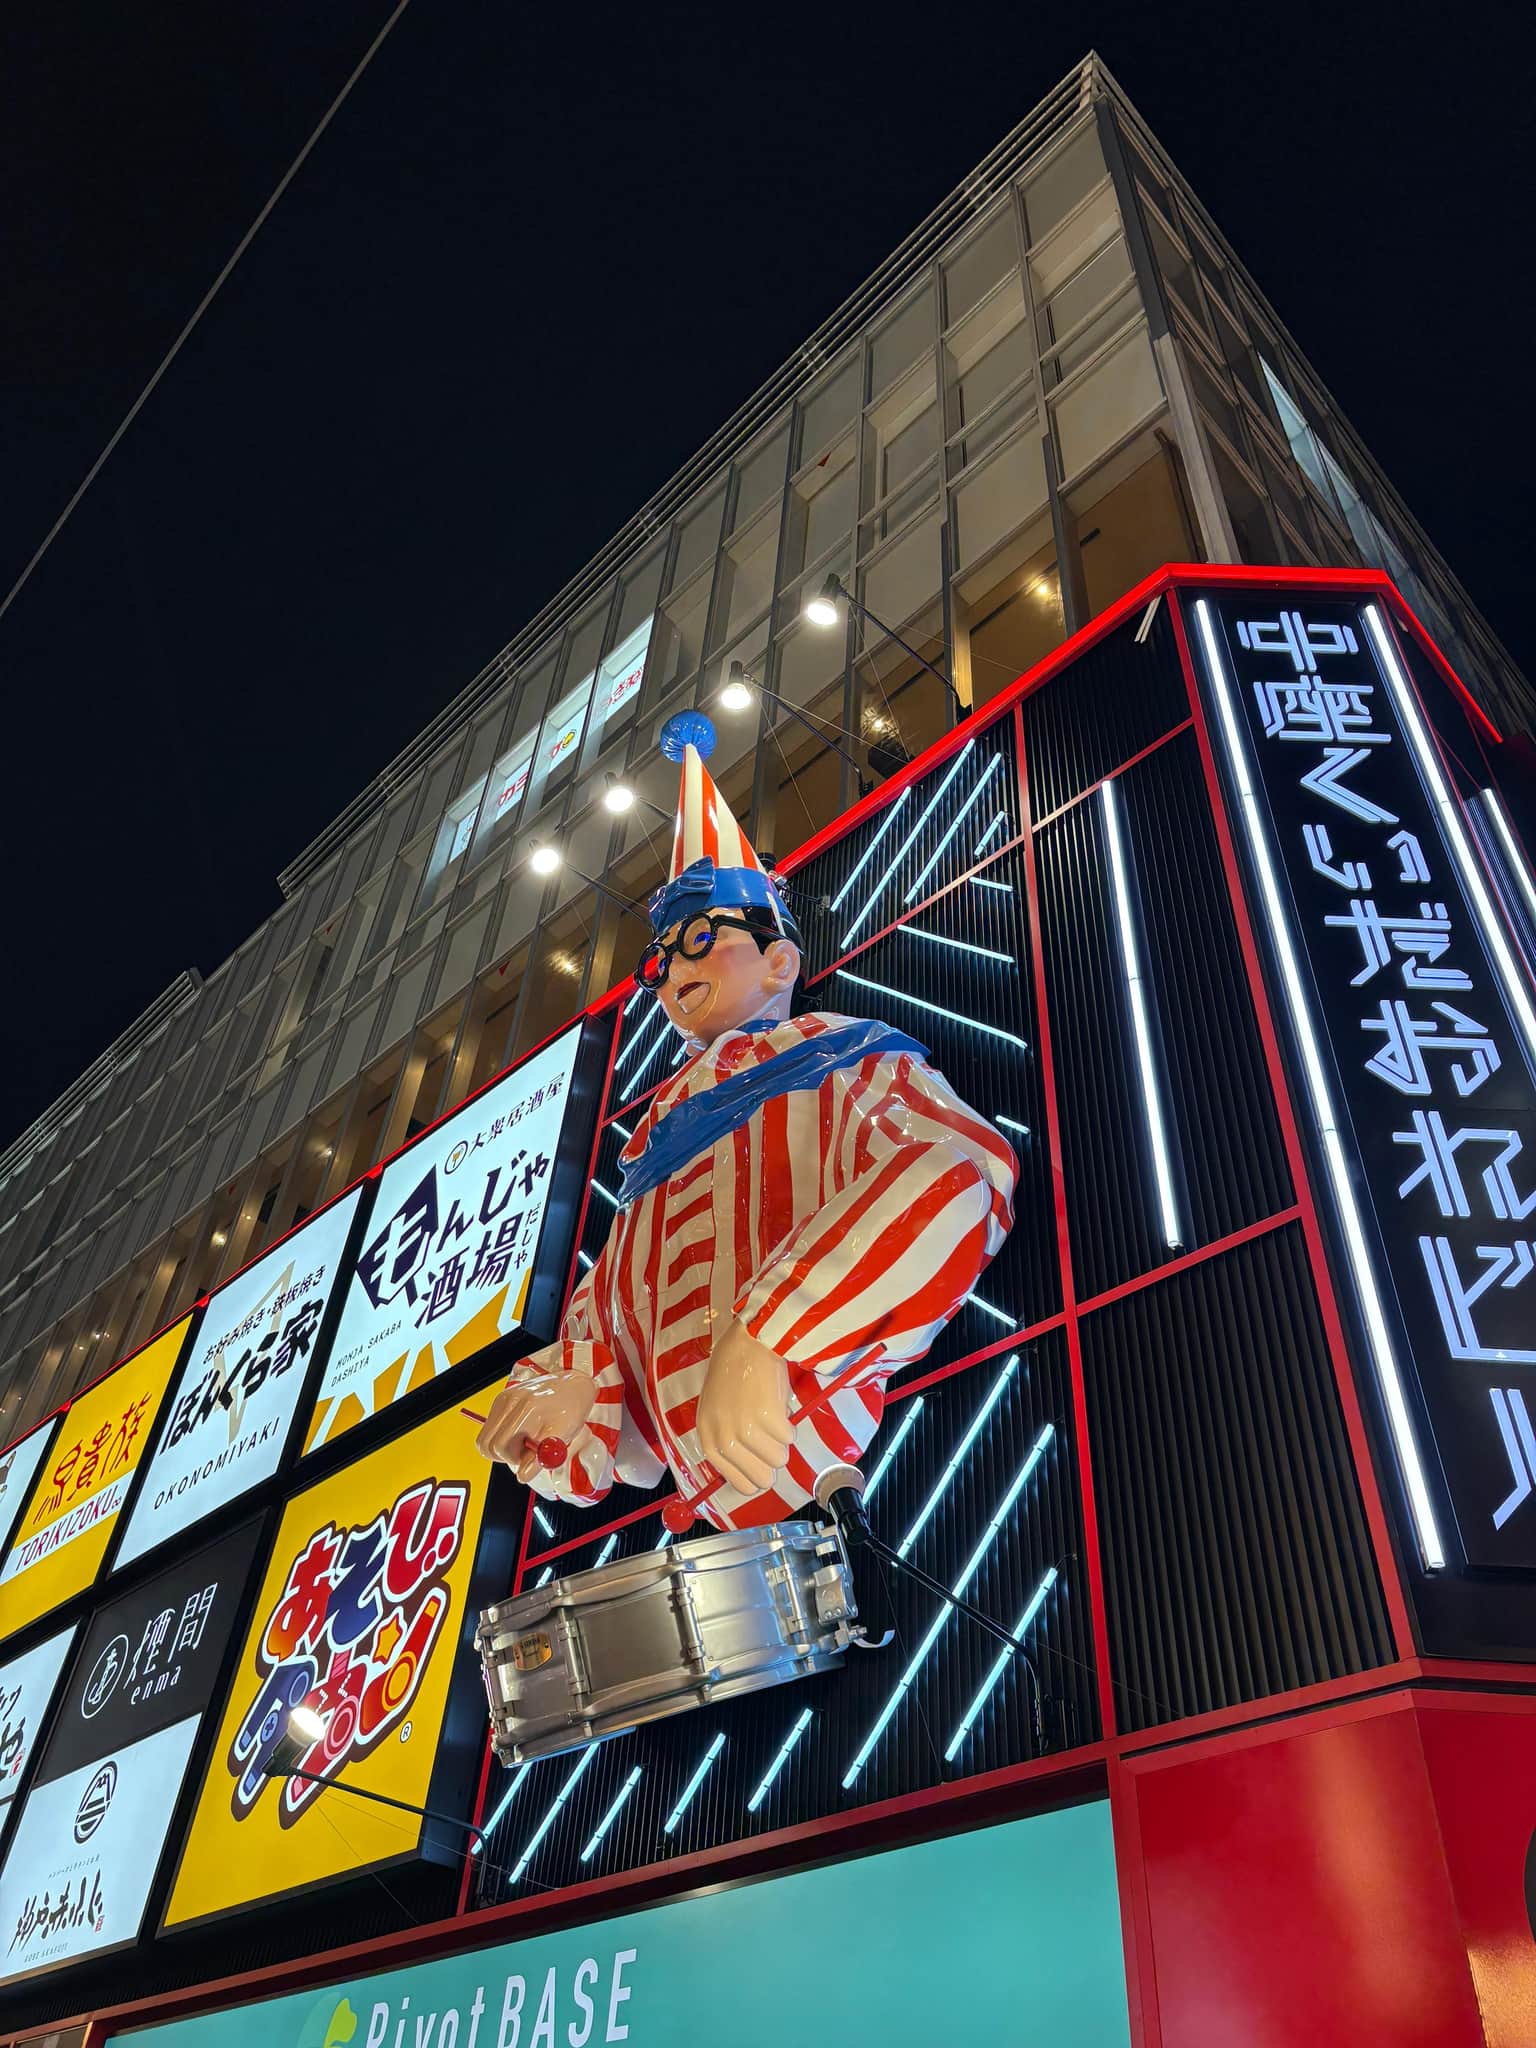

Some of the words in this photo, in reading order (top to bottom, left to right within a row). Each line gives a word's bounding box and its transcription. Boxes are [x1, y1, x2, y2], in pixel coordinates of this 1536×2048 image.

[368, 1149, 551, 1306] もんじゃ
[414, 1211, 524, 1330] 酒場
[203, 1264, 326, 1364] お好み焼き・鉄板焼き
[368, 1319, 402, 1349] SAKABA
[160, 1298, 324, 1455] ぼんくら家
[331, 1355, 370, 1387] DASHIYA
[154, 1416, 280, 1510] OKONOMIYAKI
[265, 1486, 464, 1663] あそび
[131, 1665, 182, 1705] enma
